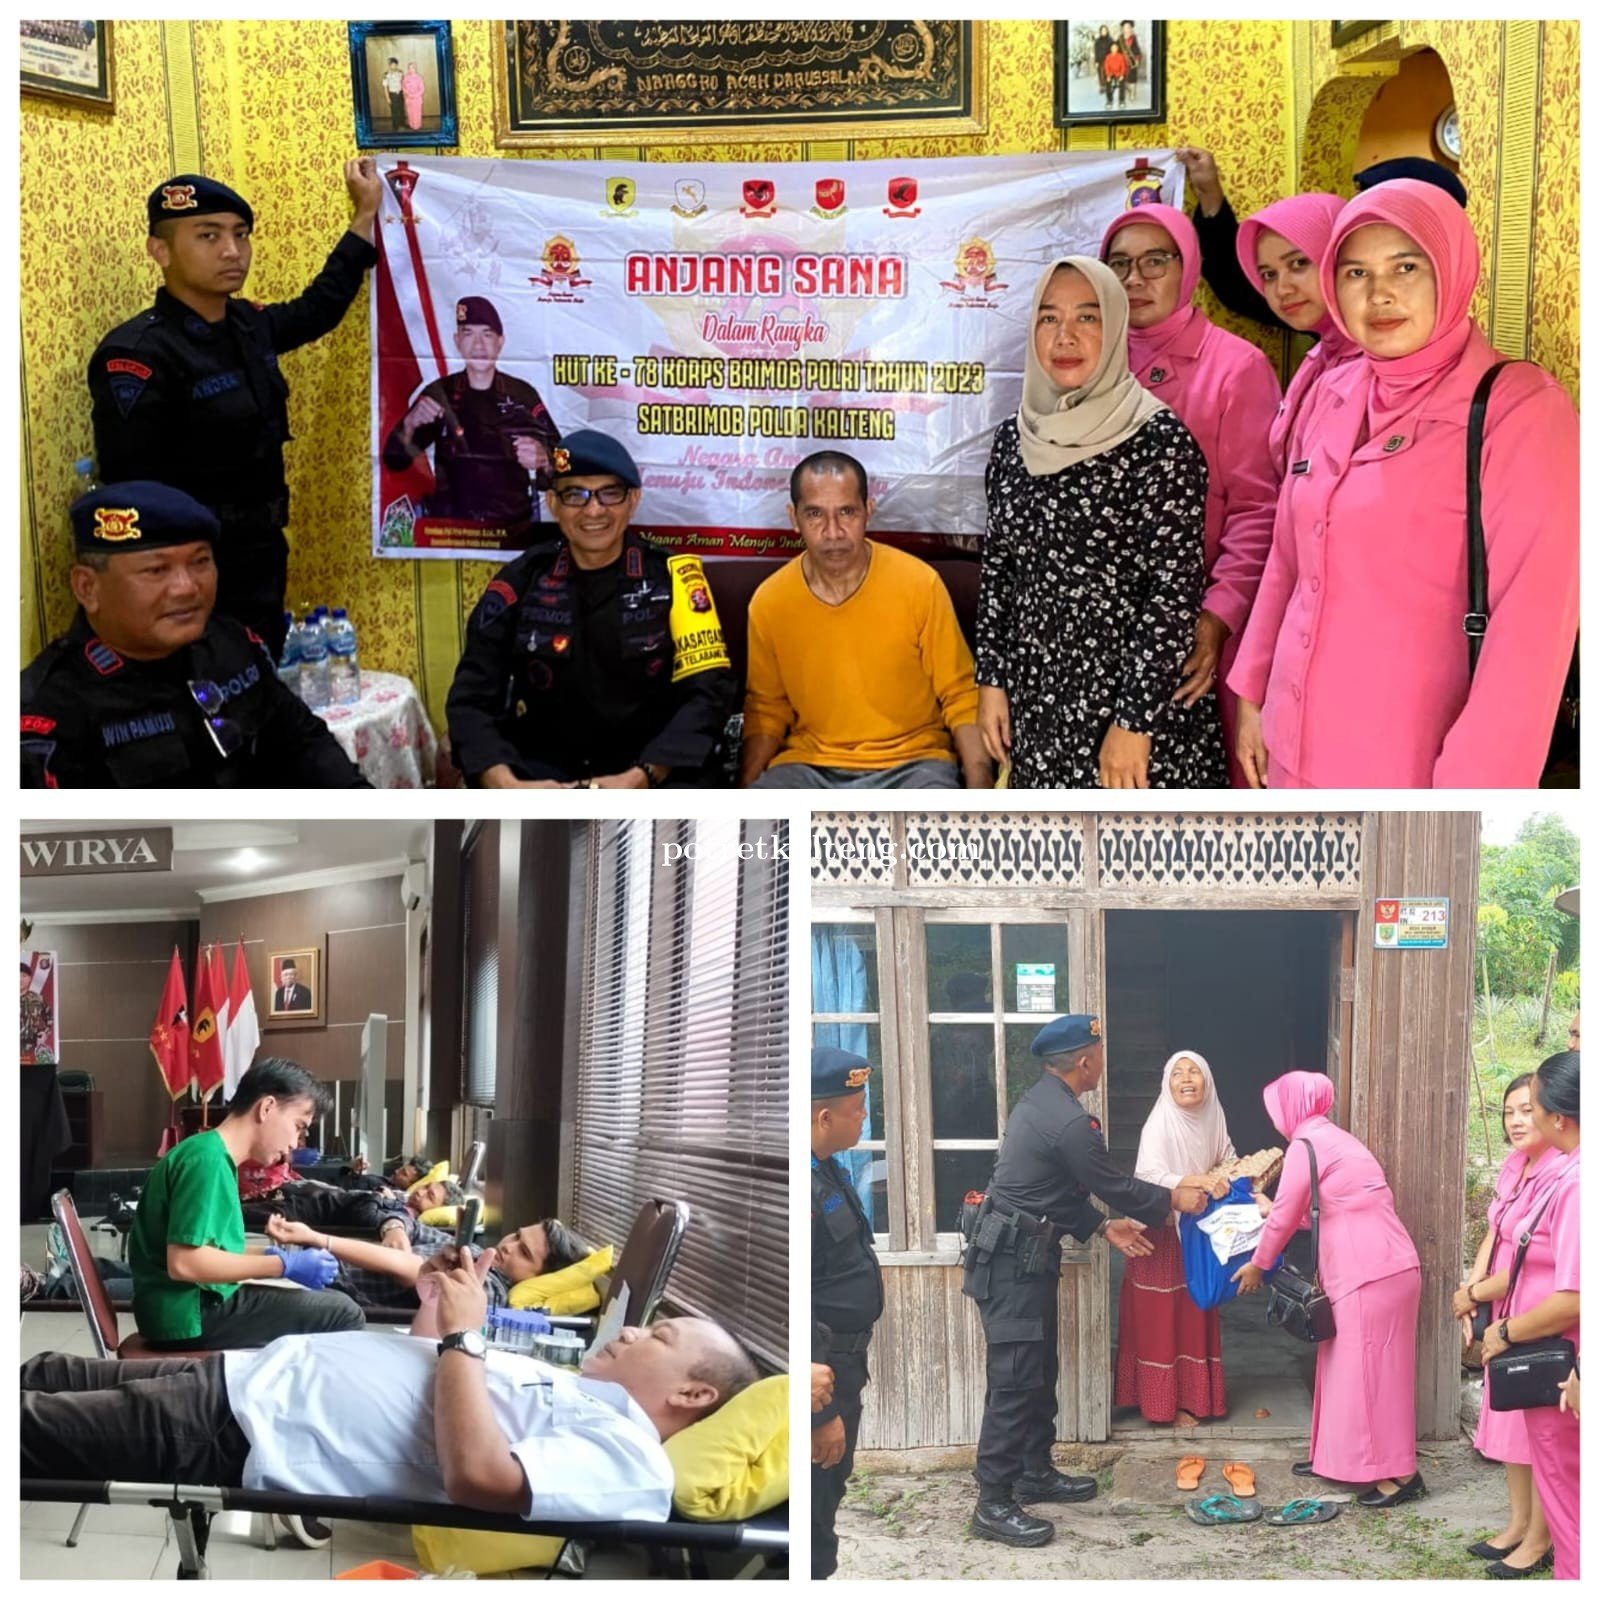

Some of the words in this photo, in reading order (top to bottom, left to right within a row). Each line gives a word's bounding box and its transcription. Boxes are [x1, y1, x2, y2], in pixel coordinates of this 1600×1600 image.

[773, 69, 869, 89] DARUSSALAM
[625, 253, 783, 297] ANJANG
[794, 254, 907, 298] SANA
[702, 312, 758, 344] Dalam
[760, 311, 827, 351] Rangka
[553, 355, 590, 385] HUT
[593, 356, 617, 386] KE
[620, 367, 631, 378] -
[633, 356, 660, 387] 78
[662, 357, 725, 389] KORPS
[728, 358, 801, 390] BRIMOB
[805, 359, 860, 392] POLRI
[863, 360, 928, 393] TAHUN
[931, 361, 985, 394] 2023
[637, 403, 746, 436] SATBRIMOB
[748, 405, 809, 438] POLDA
[813, 407, 896, 440] KALTENG
[677, 444, 759, 471] Negara
[763, 446, 803, 467] Am
[686, 532, 724, 547] Aman
[727, 533, 776, 555] Menuju
[21, 837, 158, 867] WIRYA
[1422, 909, 1448, 922] 213
